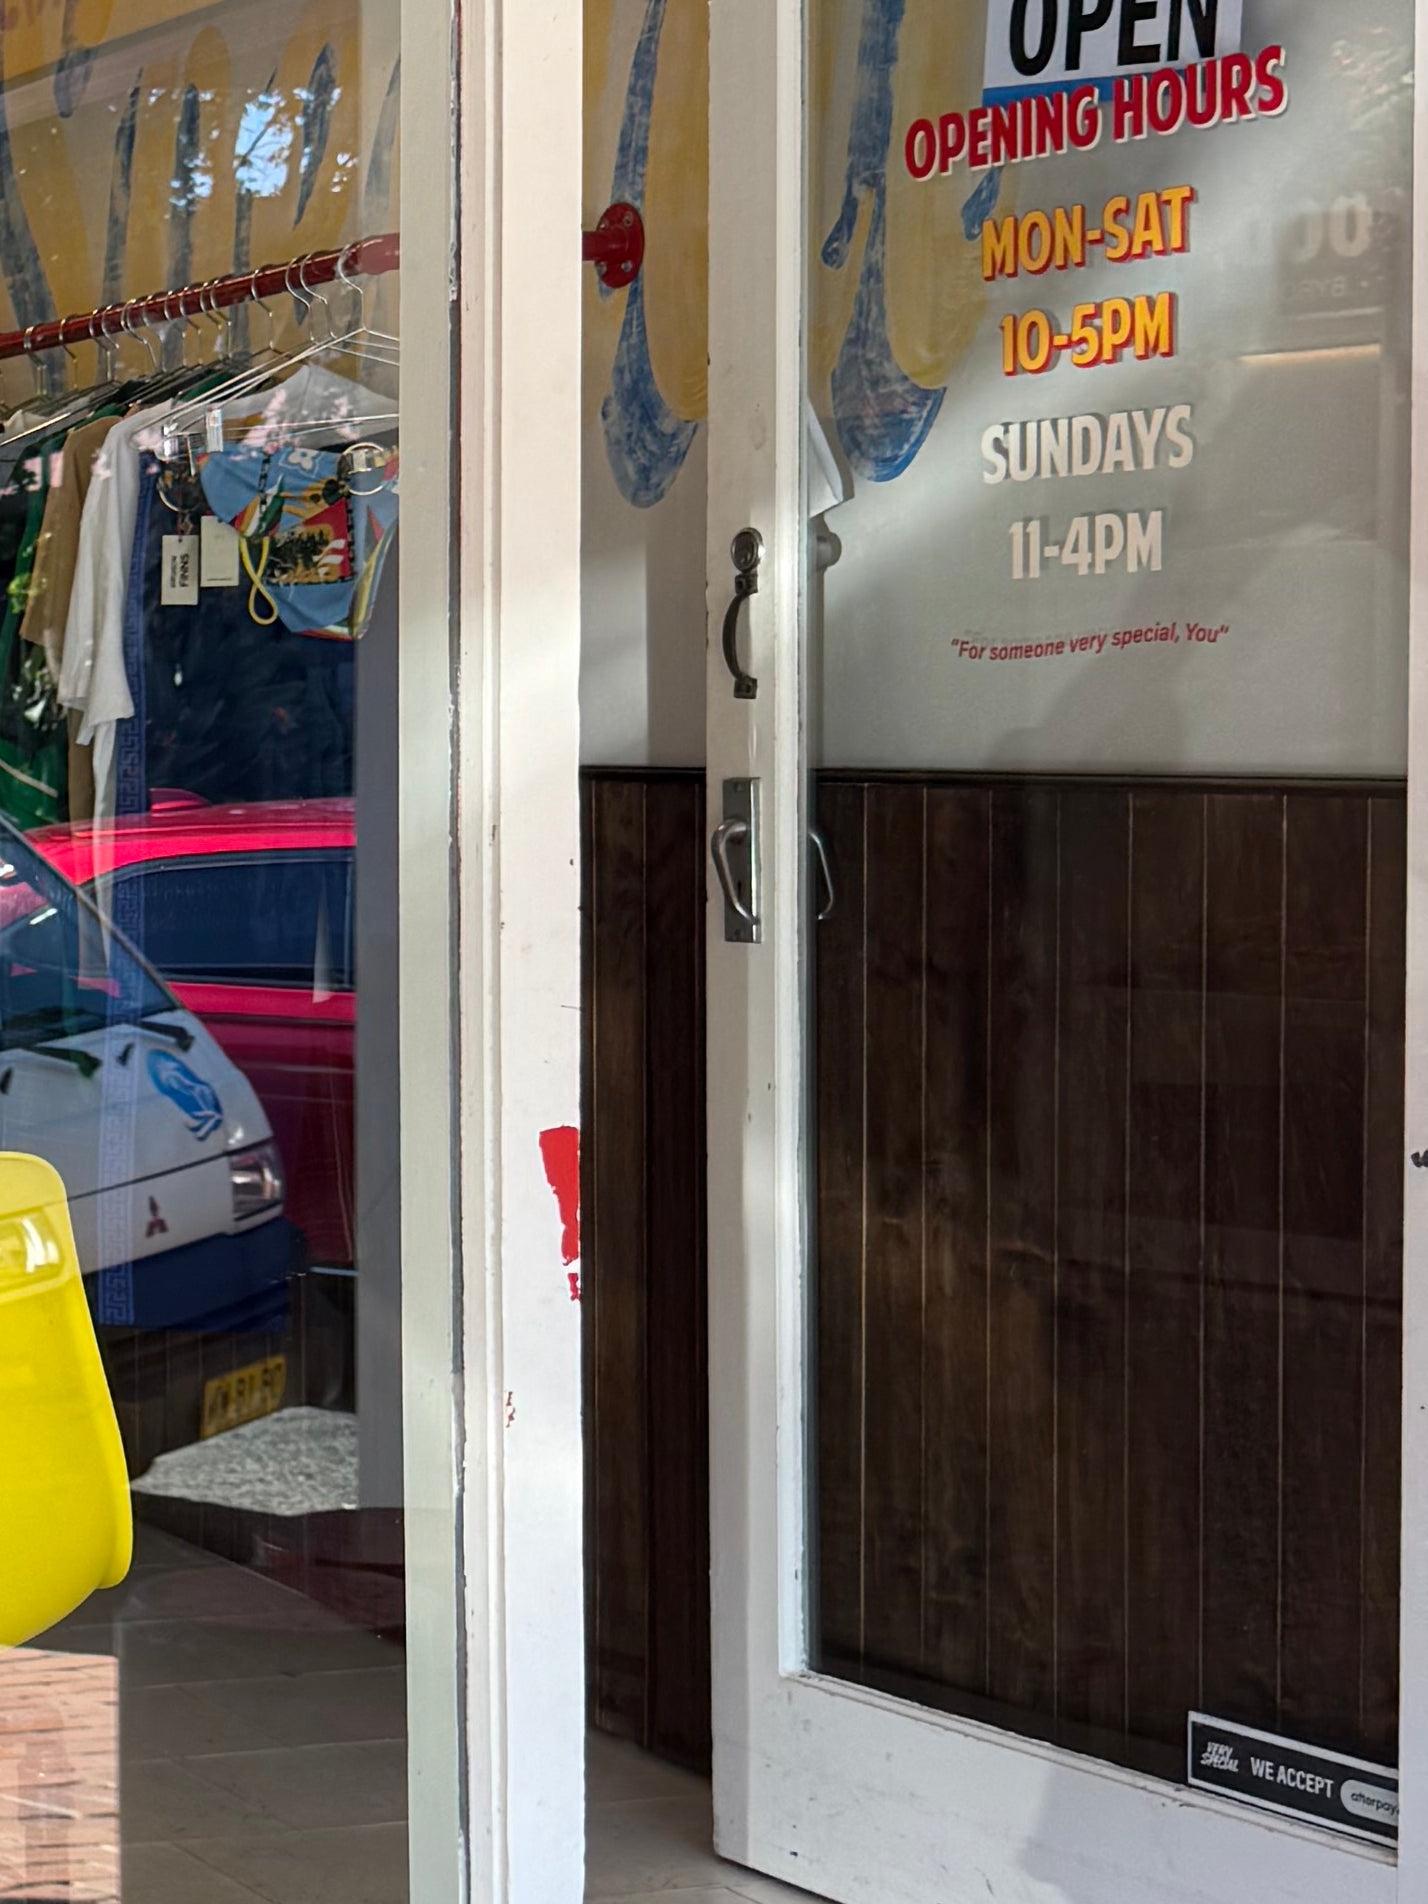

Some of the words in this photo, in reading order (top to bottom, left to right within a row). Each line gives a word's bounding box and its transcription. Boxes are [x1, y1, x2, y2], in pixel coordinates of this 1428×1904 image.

[904, 85, 1103, 182] OPENING
[1112, 45, 1289, 144] HOURS
[981, 185, 1197, 283] MON-SAT
[999, 291, 1178, 376] 10-5PM
[980, 404, 1196, 486] SUNDAYS
[1009, 508, 1165, 581] 11-4PM
[989, 639, 1065, 661] someone
[1068, 633, 1107, 654] very
[1111, 621, 1180, 650] special,
[1250, 1756, 1274, 1781] WE
[1276, 1765, 1335, 1798] ACCEPT
